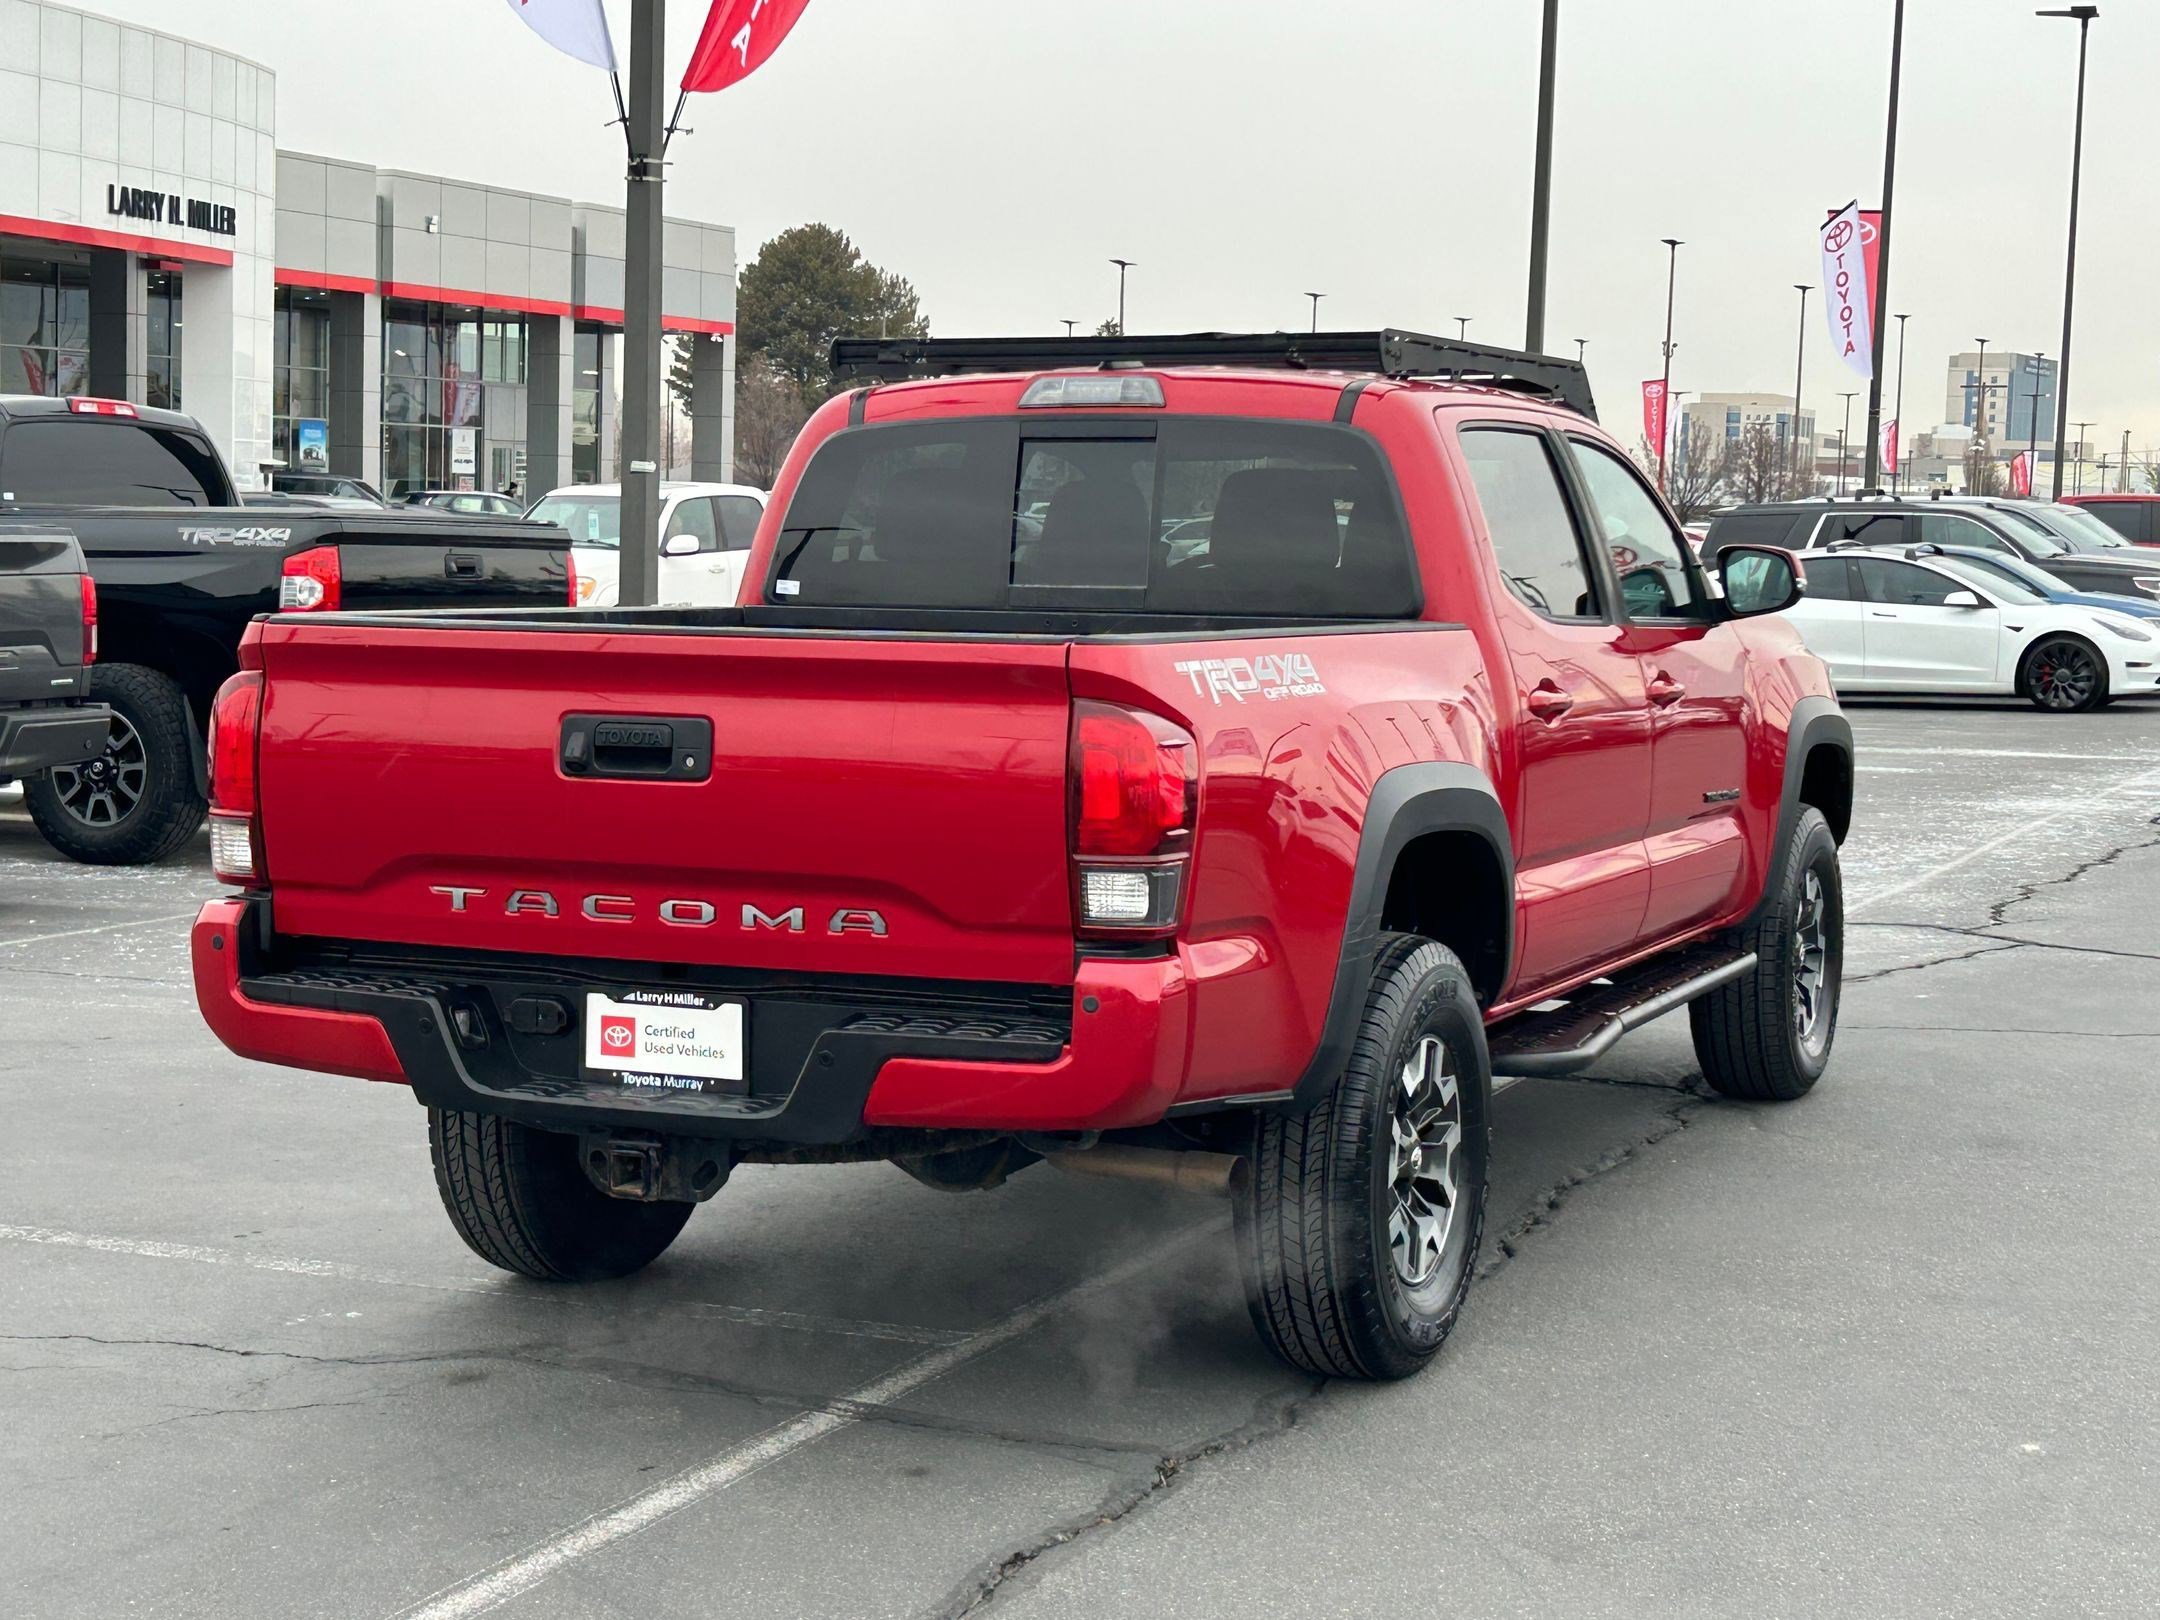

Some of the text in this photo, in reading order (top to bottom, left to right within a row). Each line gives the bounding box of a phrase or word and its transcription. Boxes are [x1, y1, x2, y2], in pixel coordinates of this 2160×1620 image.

[108, 184, 165, 222] LARRY
[187, 199, 236, 236] MILLER
[1836, 253, 1855, 357] TOYOTA
[600, 729, 664, 745] TOYOTA
[428, 885, 889, 938] TACOMA
[636, 991, 664, 1005] Larry
[674, 993, 705, 1006] Miller
[644, 1025, 695, 1039] Certified
[645, 1042, 725, 1059] Used Vehicles
[621, 1072, 704, 1091] Toyota Murray
